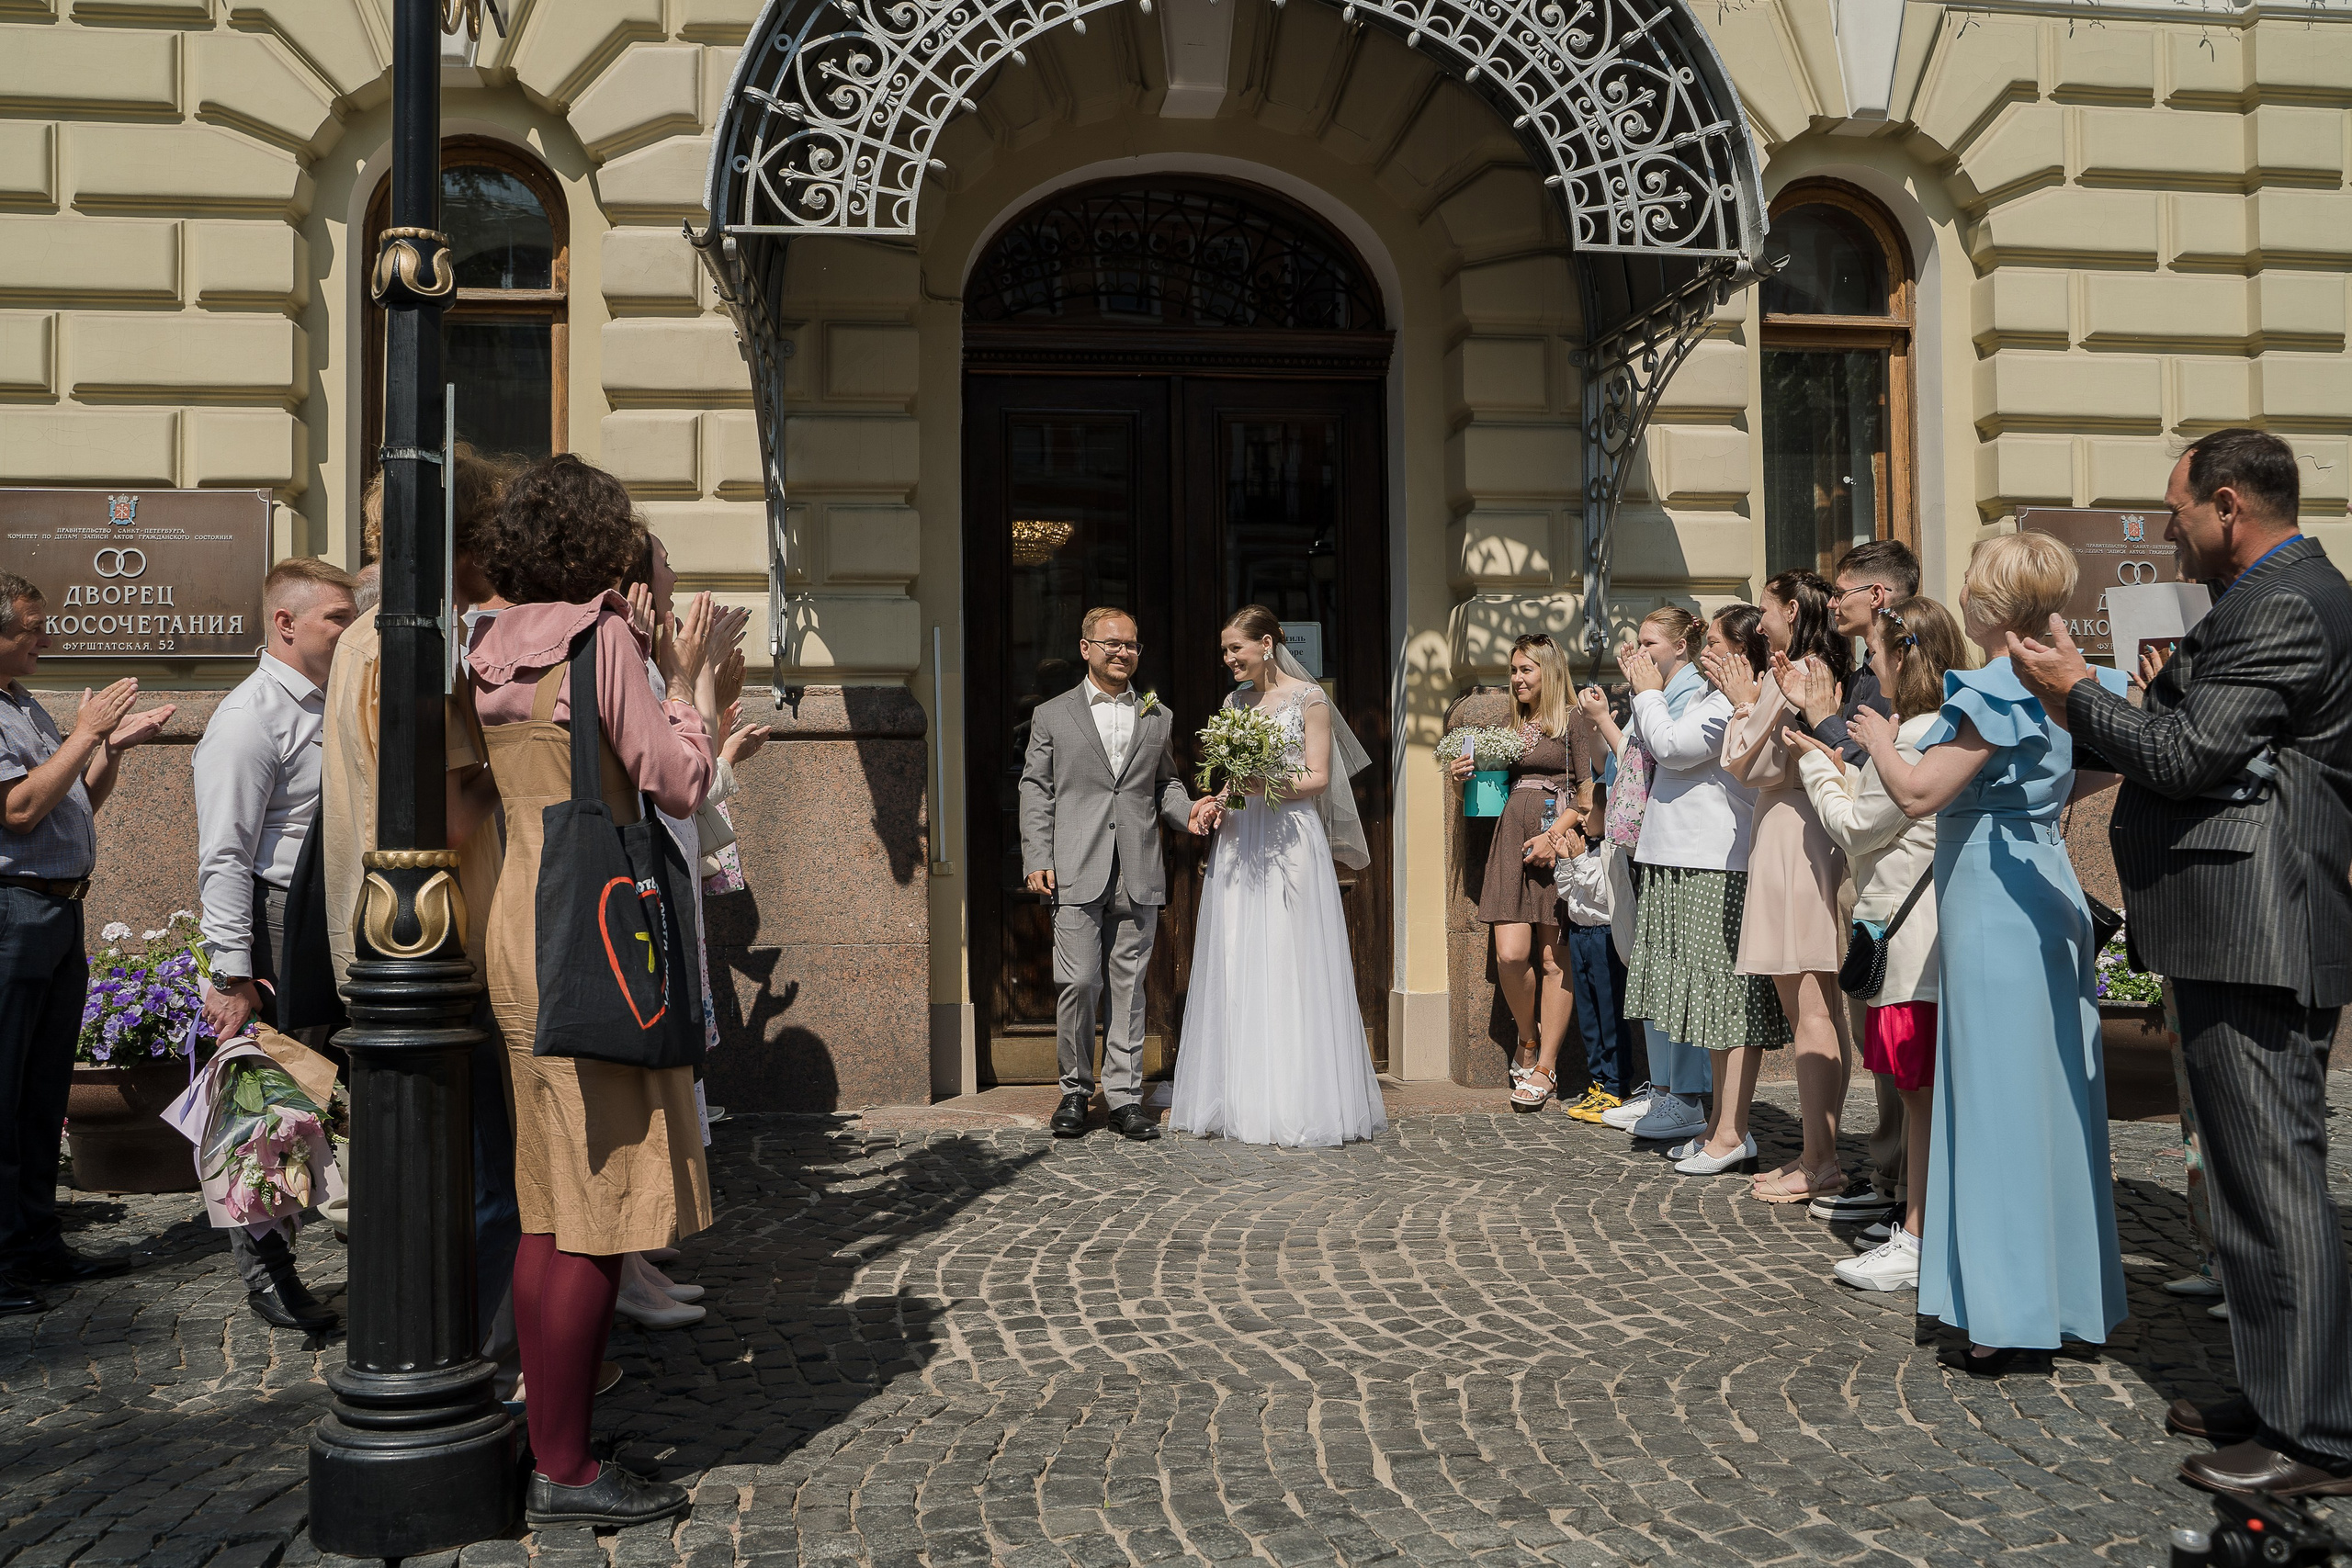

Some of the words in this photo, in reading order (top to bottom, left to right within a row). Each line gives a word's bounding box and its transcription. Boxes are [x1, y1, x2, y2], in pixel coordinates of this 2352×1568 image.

[63, 585, 175, 607] ДВОРЕЦ
[46, 615, 243, 635] КОСОЧЕТАНИЯ
[158, 639, 175, 650] 52
